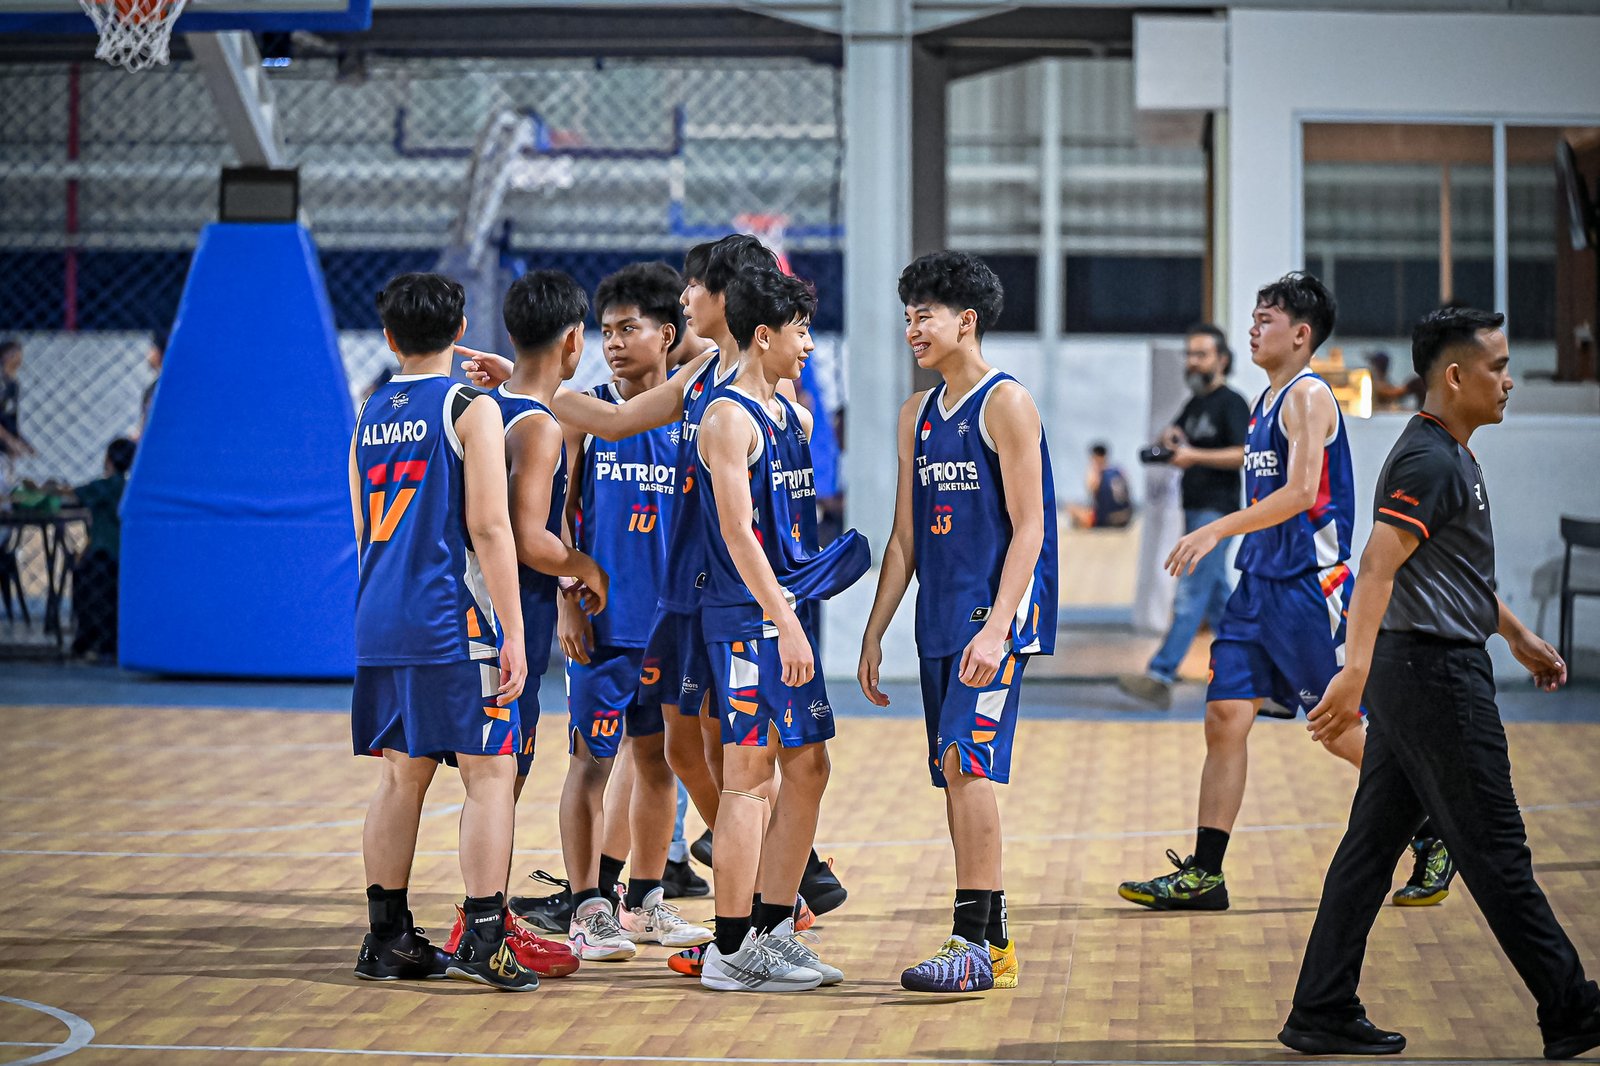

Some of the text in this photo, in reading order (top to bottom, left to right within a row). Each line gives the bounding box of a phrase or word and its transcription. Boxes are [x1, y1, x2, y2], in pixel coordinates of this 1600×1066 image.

[362, 419, 428, 446] ALVARO
[595, 451, 617, 462] THE
[367, 459, 428, 544] 17
[627, 502, 659, 533] 10
[790, 513, 801, 543] 4
[590, 709, 620, 738] 10
[783, 699, 794, 728] 4
